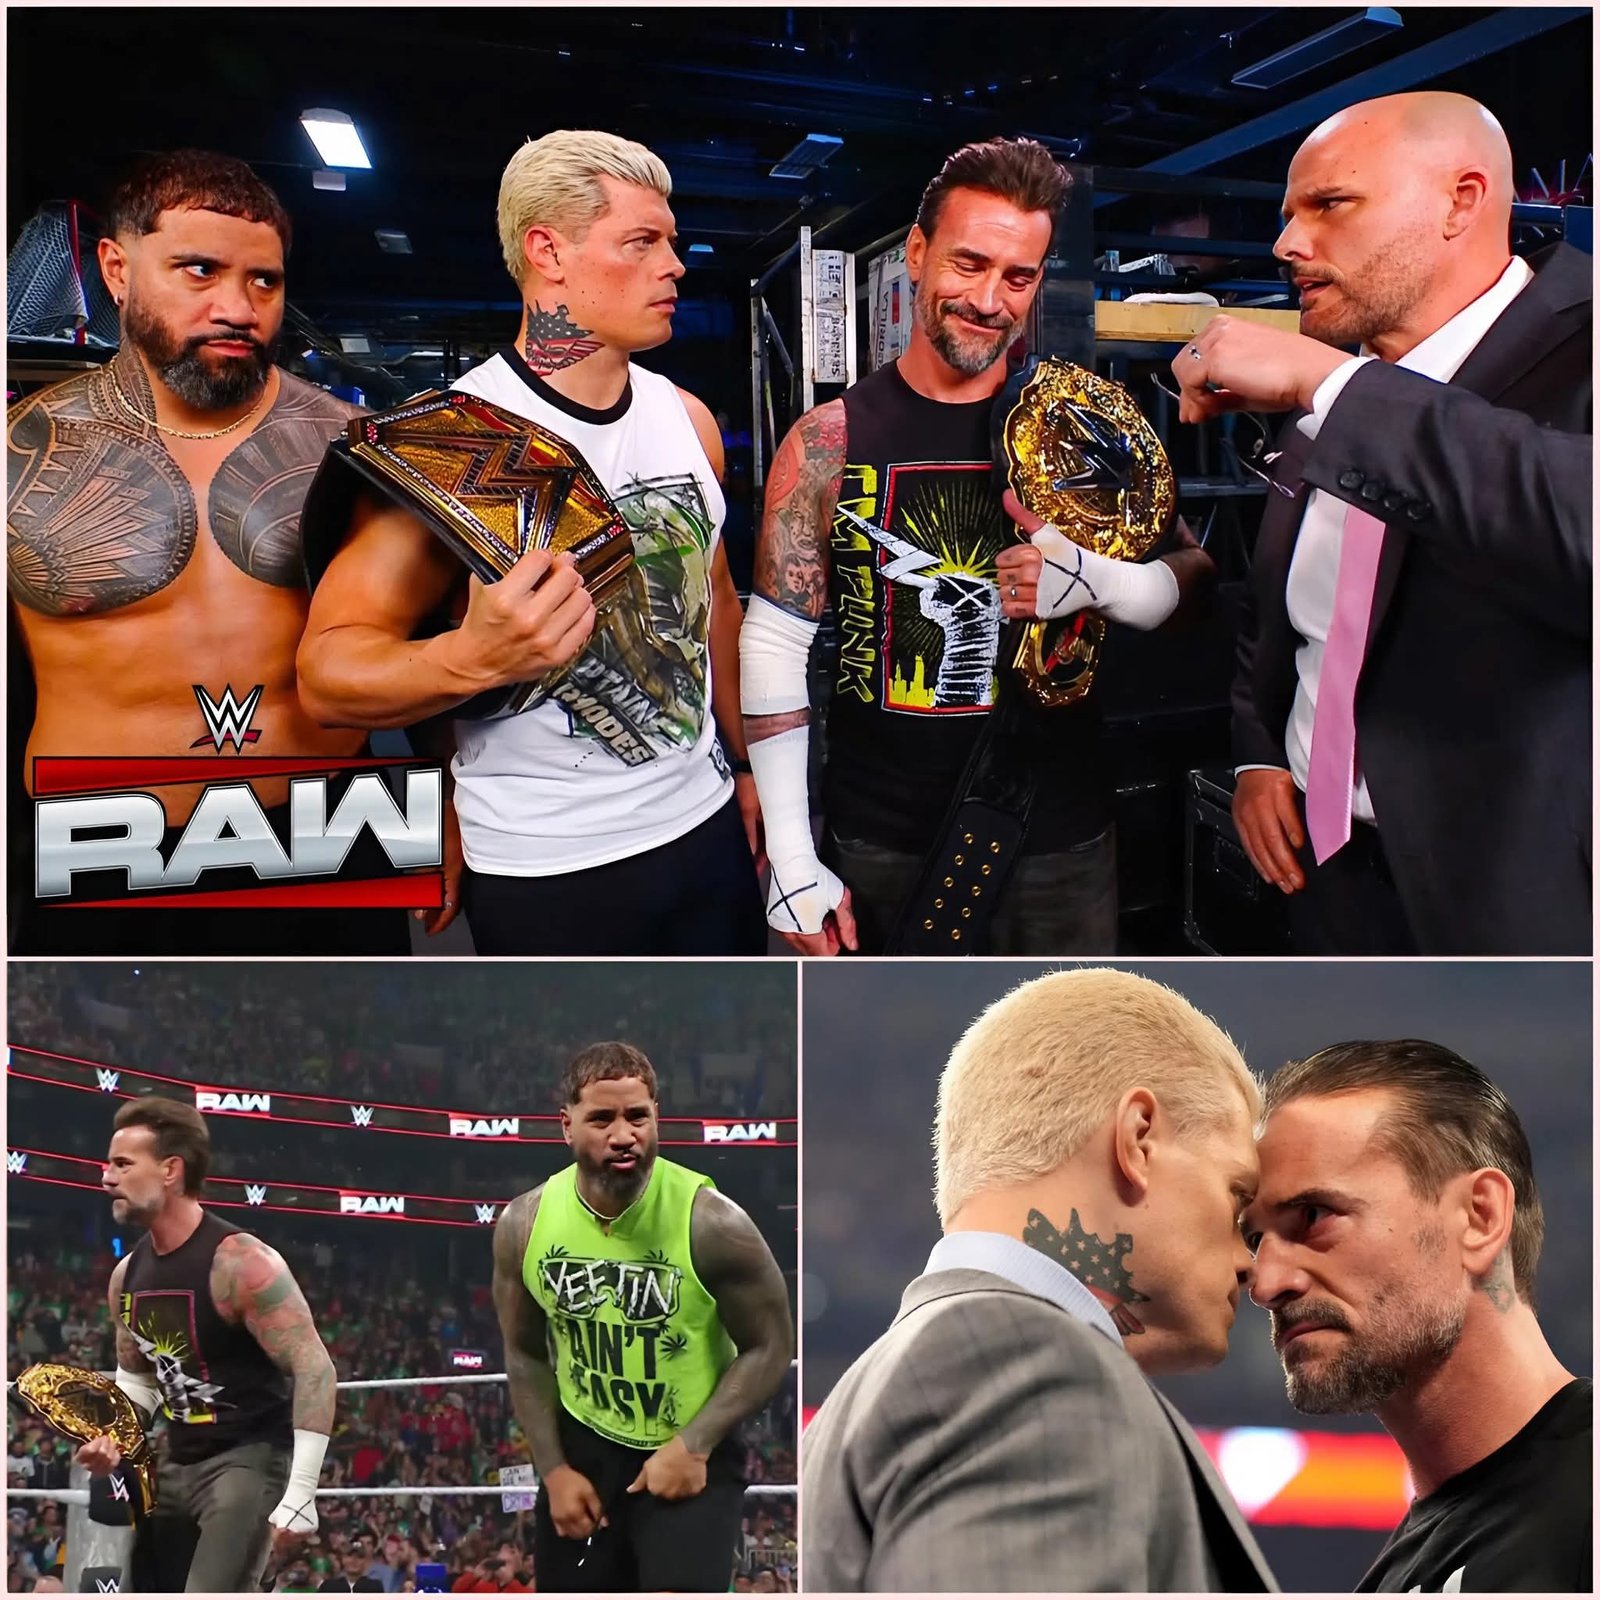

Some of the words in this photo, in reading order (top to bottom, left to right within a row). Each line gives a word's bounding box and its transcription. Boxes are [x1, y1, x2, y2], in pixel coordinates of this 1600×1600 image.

[836, 564, 876, 703] PUNK
[196, 1092, 270, 1112] RAW
[450, 1118, 519, 1138] RAW
[704, 1122, 777, 1142] RAW
[340, 1197, 404, 1213] RAW
[566, 1318, 661, 1380] AIN'T
[453, 1355, 482, 1367] RAW
